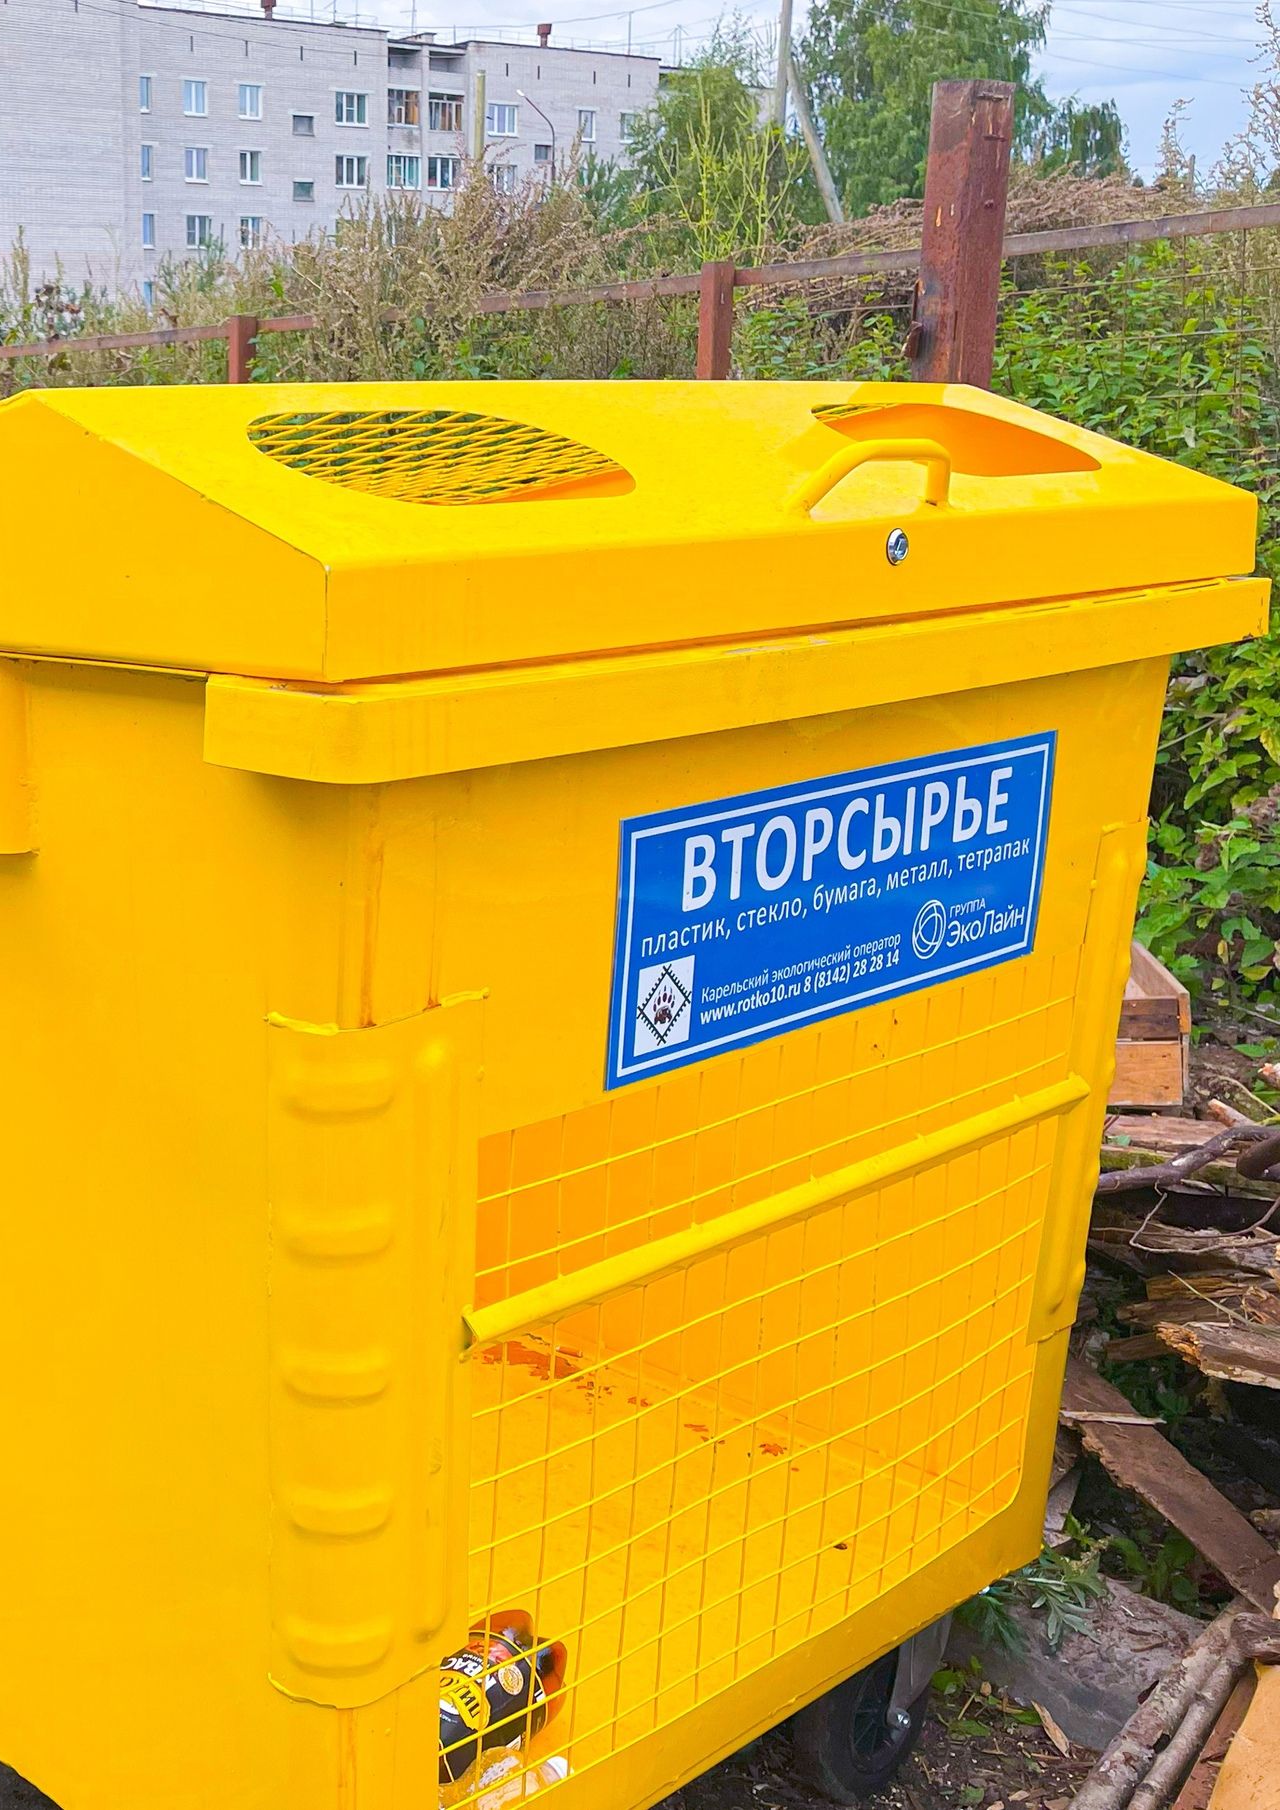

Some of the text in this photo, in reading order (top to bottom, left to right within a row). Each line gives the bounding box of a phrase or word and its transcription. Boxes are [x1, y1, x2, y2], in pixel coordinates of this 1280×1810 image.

[682, 766, 1013, 912] ВТОРСЫРЬЕ
[641, 838, 1030, 957] пластик, стекло, бумага, металл, тетрапак
[946, 904, 1025, 948] ЭкоЛайн
[949, 898, 986, 918] ГРУППА
[700, 949, 900, 1025] www.rotko10.ru 8 (8142) 28 28 14
[701, 933, 901, 1004] Карельский экологический оператор
